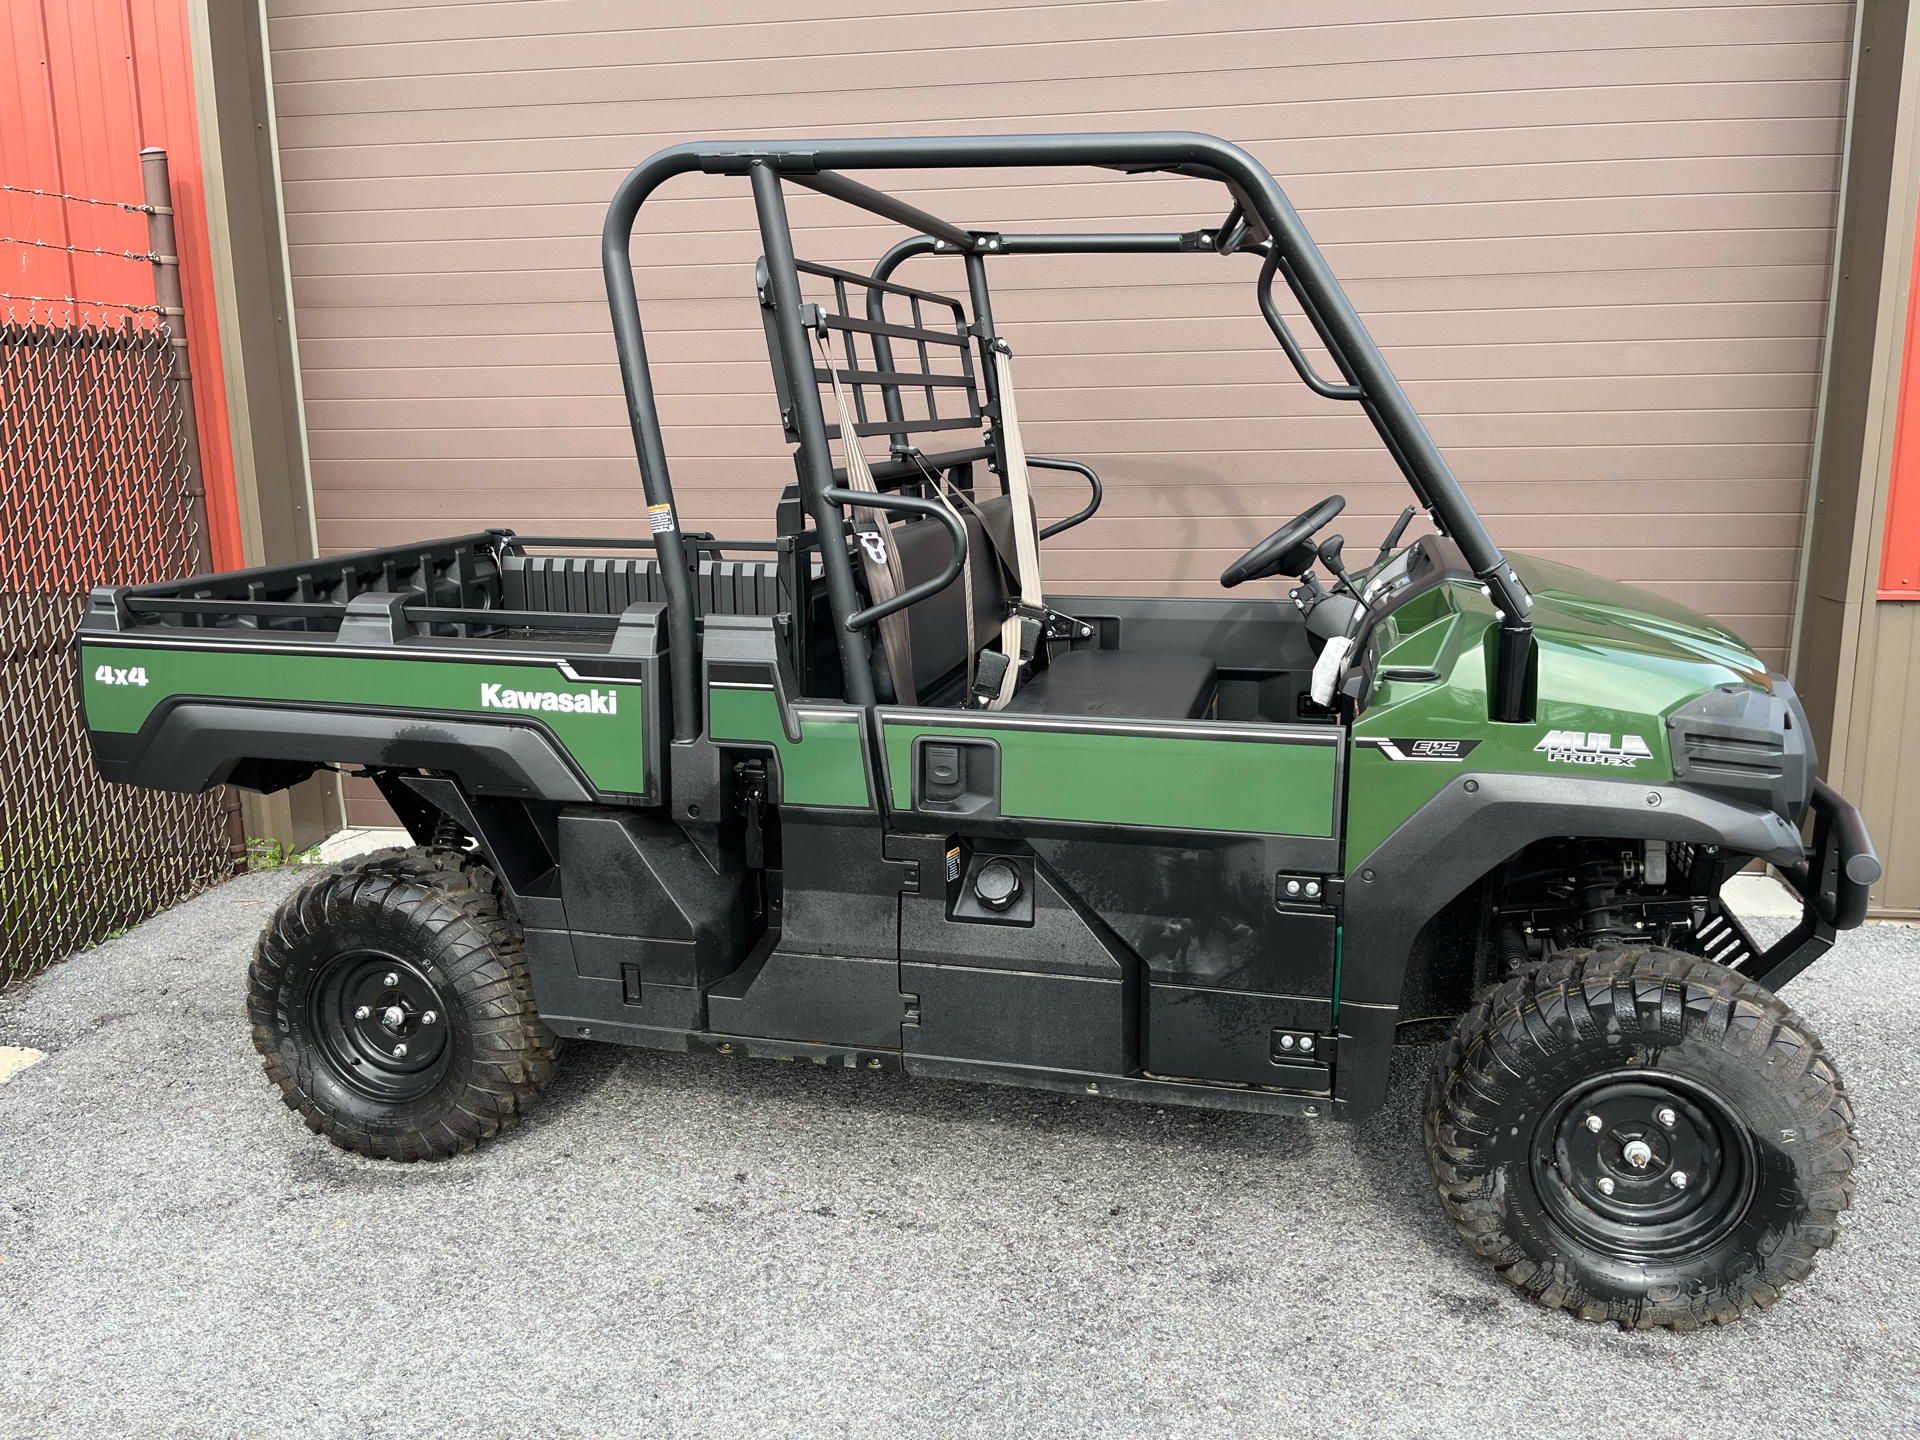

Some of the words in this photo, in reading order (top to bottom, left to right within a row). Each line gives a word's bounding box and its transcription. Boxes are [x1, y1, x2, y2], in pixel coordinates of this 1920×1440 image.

[95, 665, 149, 686] 4x4
[481, 682, 617, 714] Kawasaki
[1533, 730, 1654, 759] MULE
[1548, 752, 1636, 767] PRO-FX
